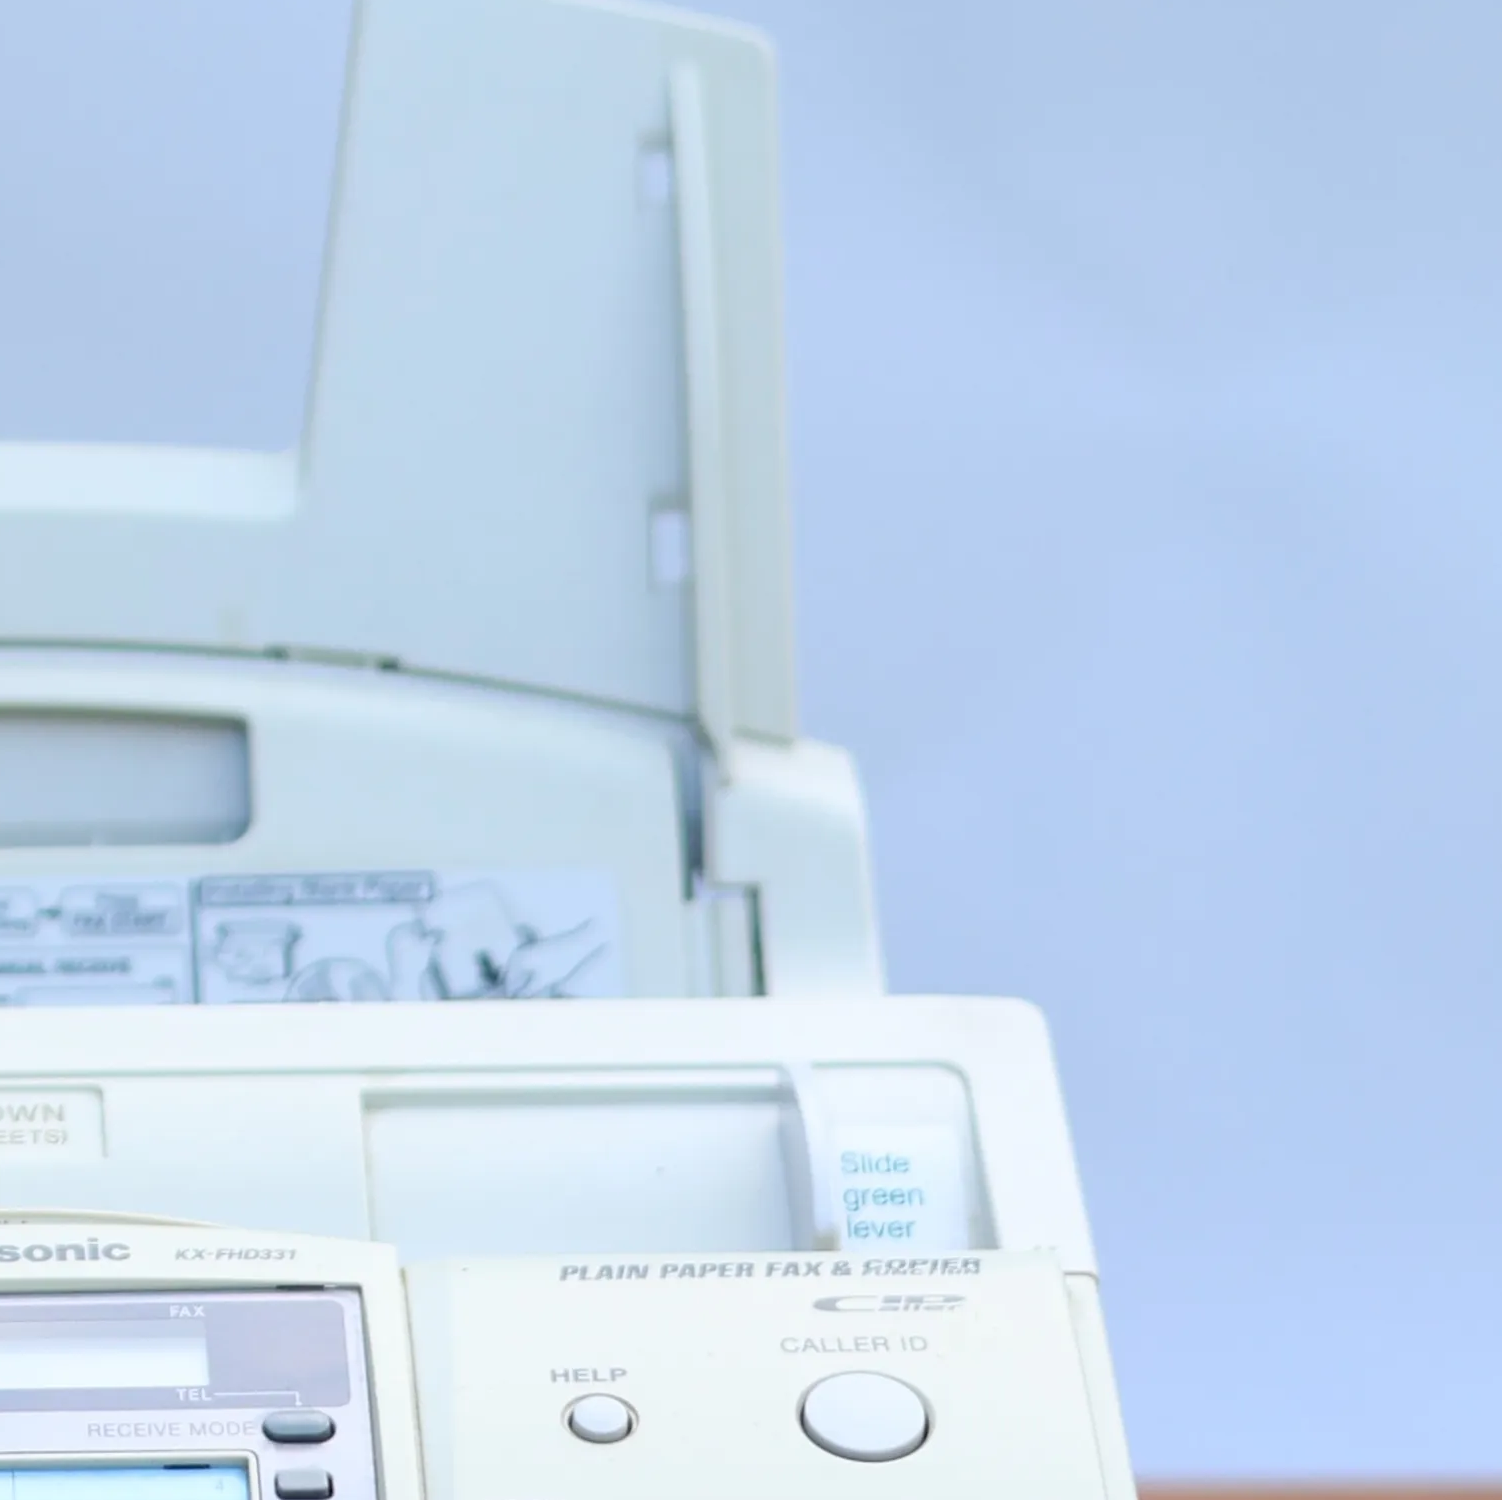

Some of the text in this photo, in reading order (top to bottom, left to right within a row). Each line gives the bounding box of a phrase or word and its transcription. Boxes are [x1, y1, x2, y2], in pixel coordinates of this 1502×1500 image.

[840, 1150, 911, 1175] Slide
[842, 1184, 925, 1211] green
[846, 1214, 916, 1239] lever
[559, 1263, 649, 1281] PLAIN
[659, 1261, 755, 1279] PAPER
[765, 1260, 825, 1278] FAX
[169, 1305, 206, 1317] FAX
[780, 1335, 929, 1354] CALLER ID
[550, 1367, 628, 1383] HELP
[176, 1387, 213, 1401] TEL
[87, 1421, 255, 1438] RECEIVE MODE
